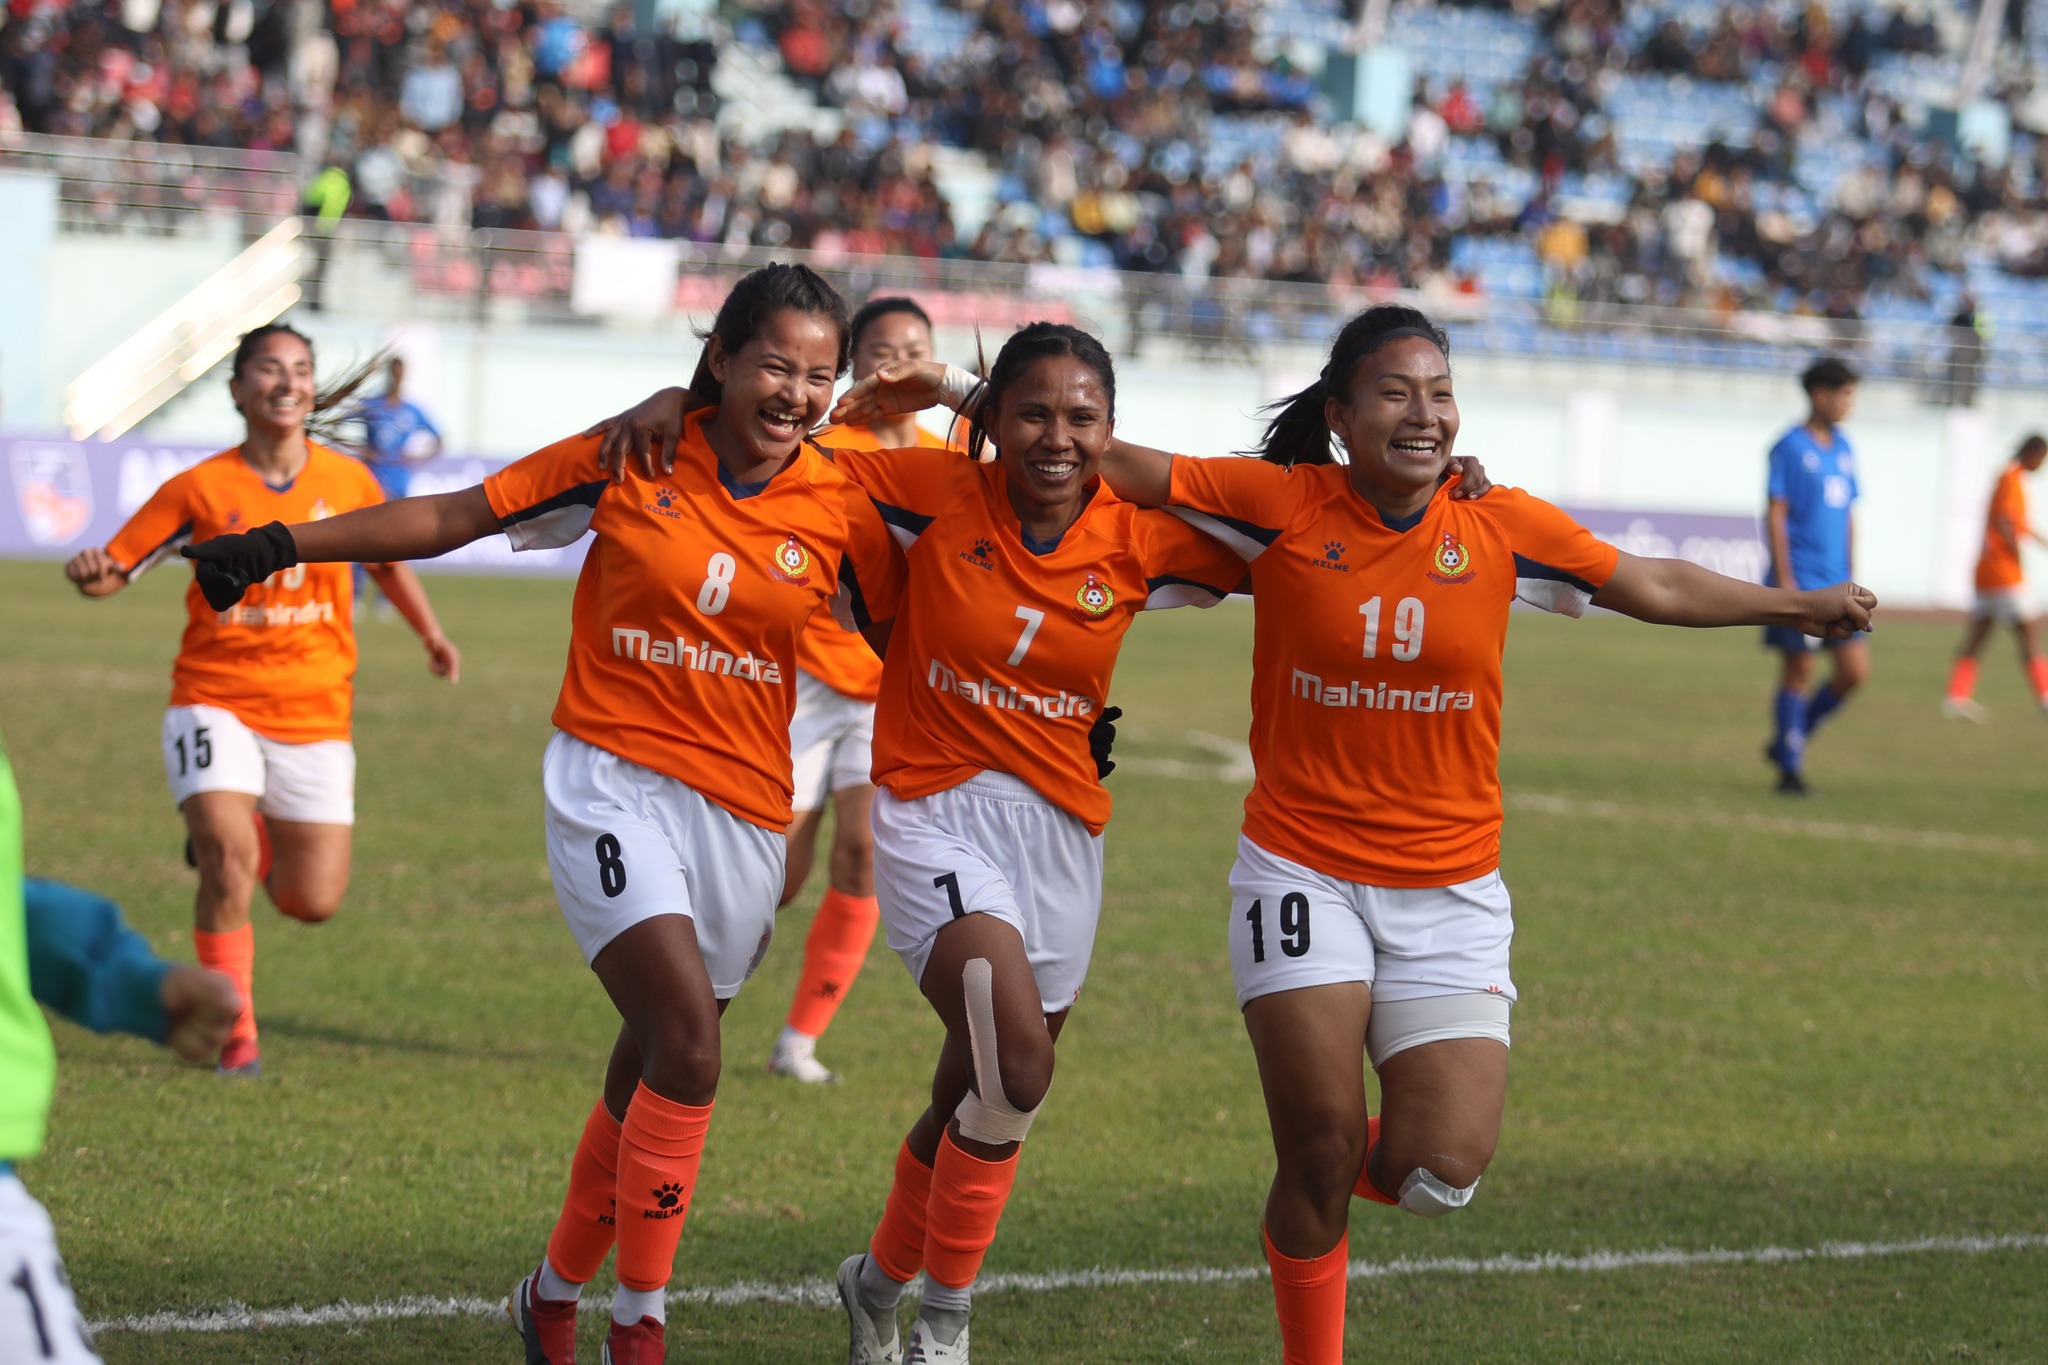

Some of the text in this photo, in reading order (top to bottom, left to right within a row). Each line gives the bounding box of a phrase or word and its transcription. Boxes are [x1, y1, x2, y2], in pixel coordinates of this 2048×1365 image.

[644, 503, 681, 519] KELME
[696, 552, 736, 616] 8
[959, 551, 994, 572] KELME
[1312, 557, 1350, 572] KELME
[1006, 605, 1045, 667] 7
[1358, 595, 1425, 662] 19
[174, 728, 212, 776] 15
[595, 833, 627, 898] 8
[1246, 891, 1311, 963] 19
